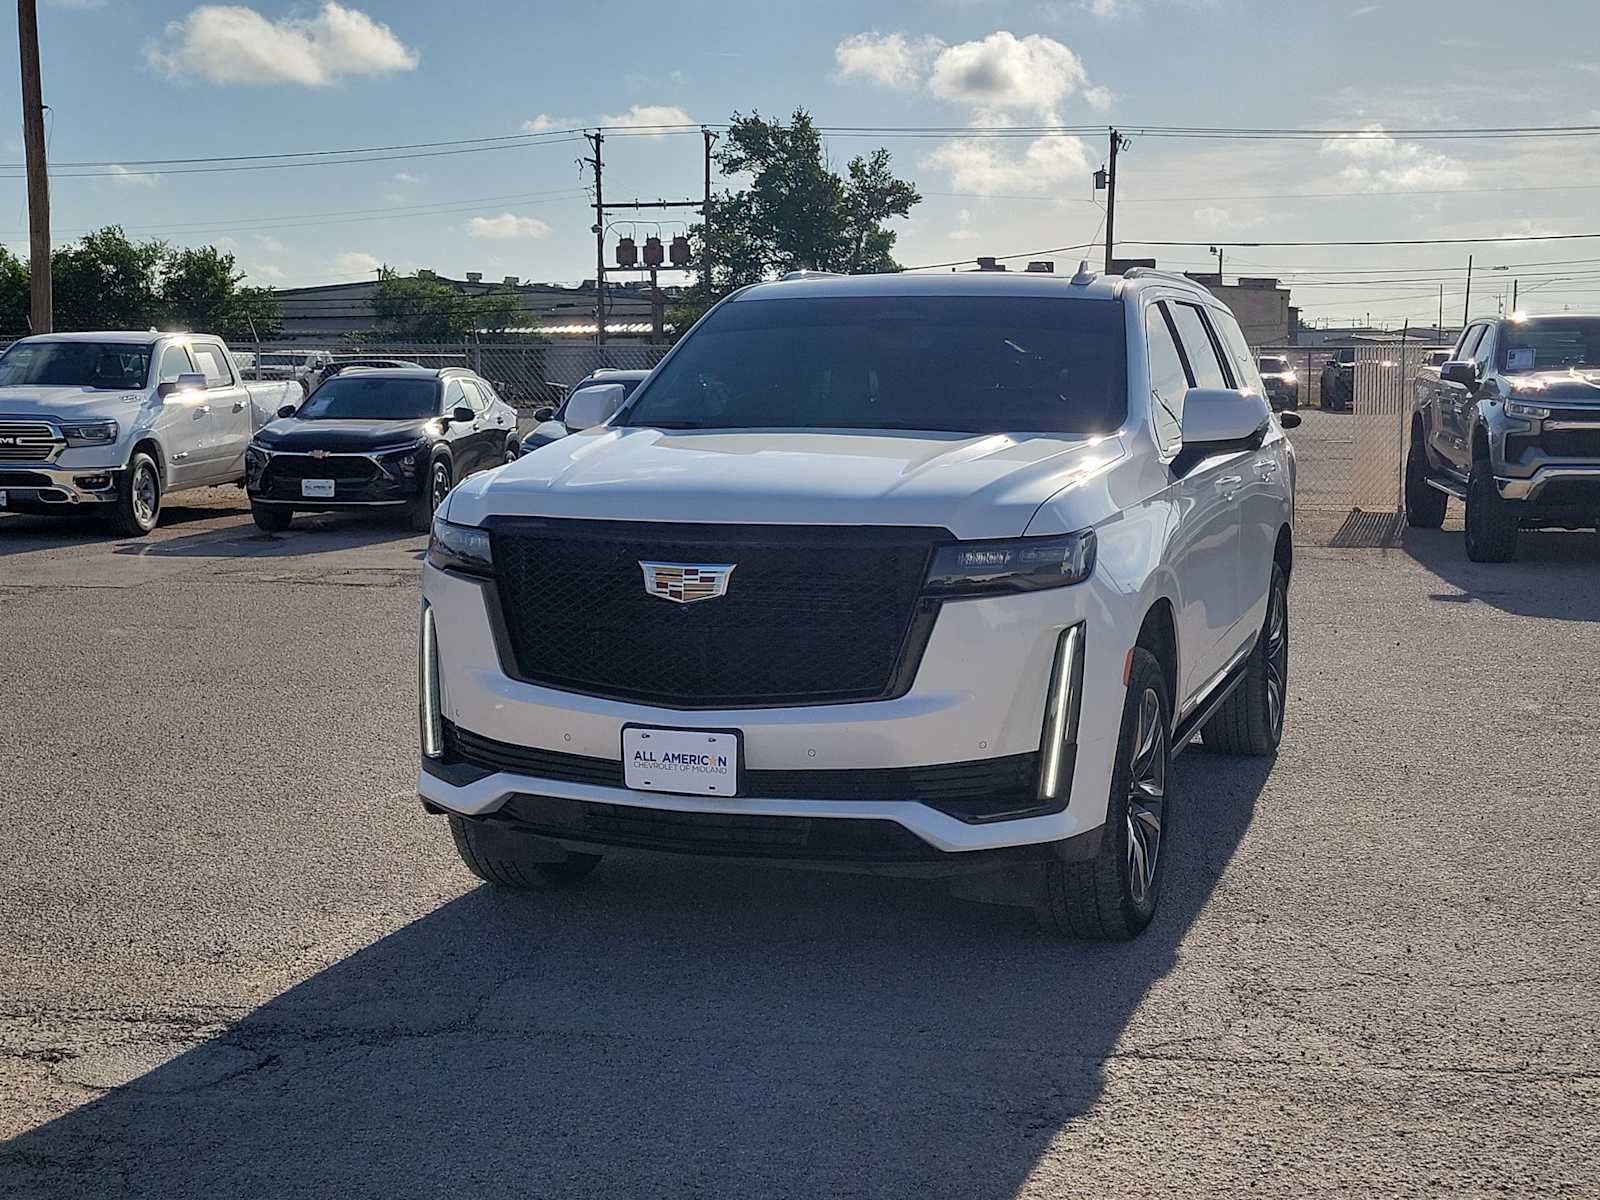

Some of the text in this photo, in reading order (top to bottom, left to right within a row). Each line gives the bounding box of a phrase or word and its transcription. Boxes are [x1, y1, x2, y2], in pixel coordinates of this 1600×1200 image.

[634, 751, 656, 762] ALL
[633, 761, 727, 775] CHEVROLET OF MIDLAND
